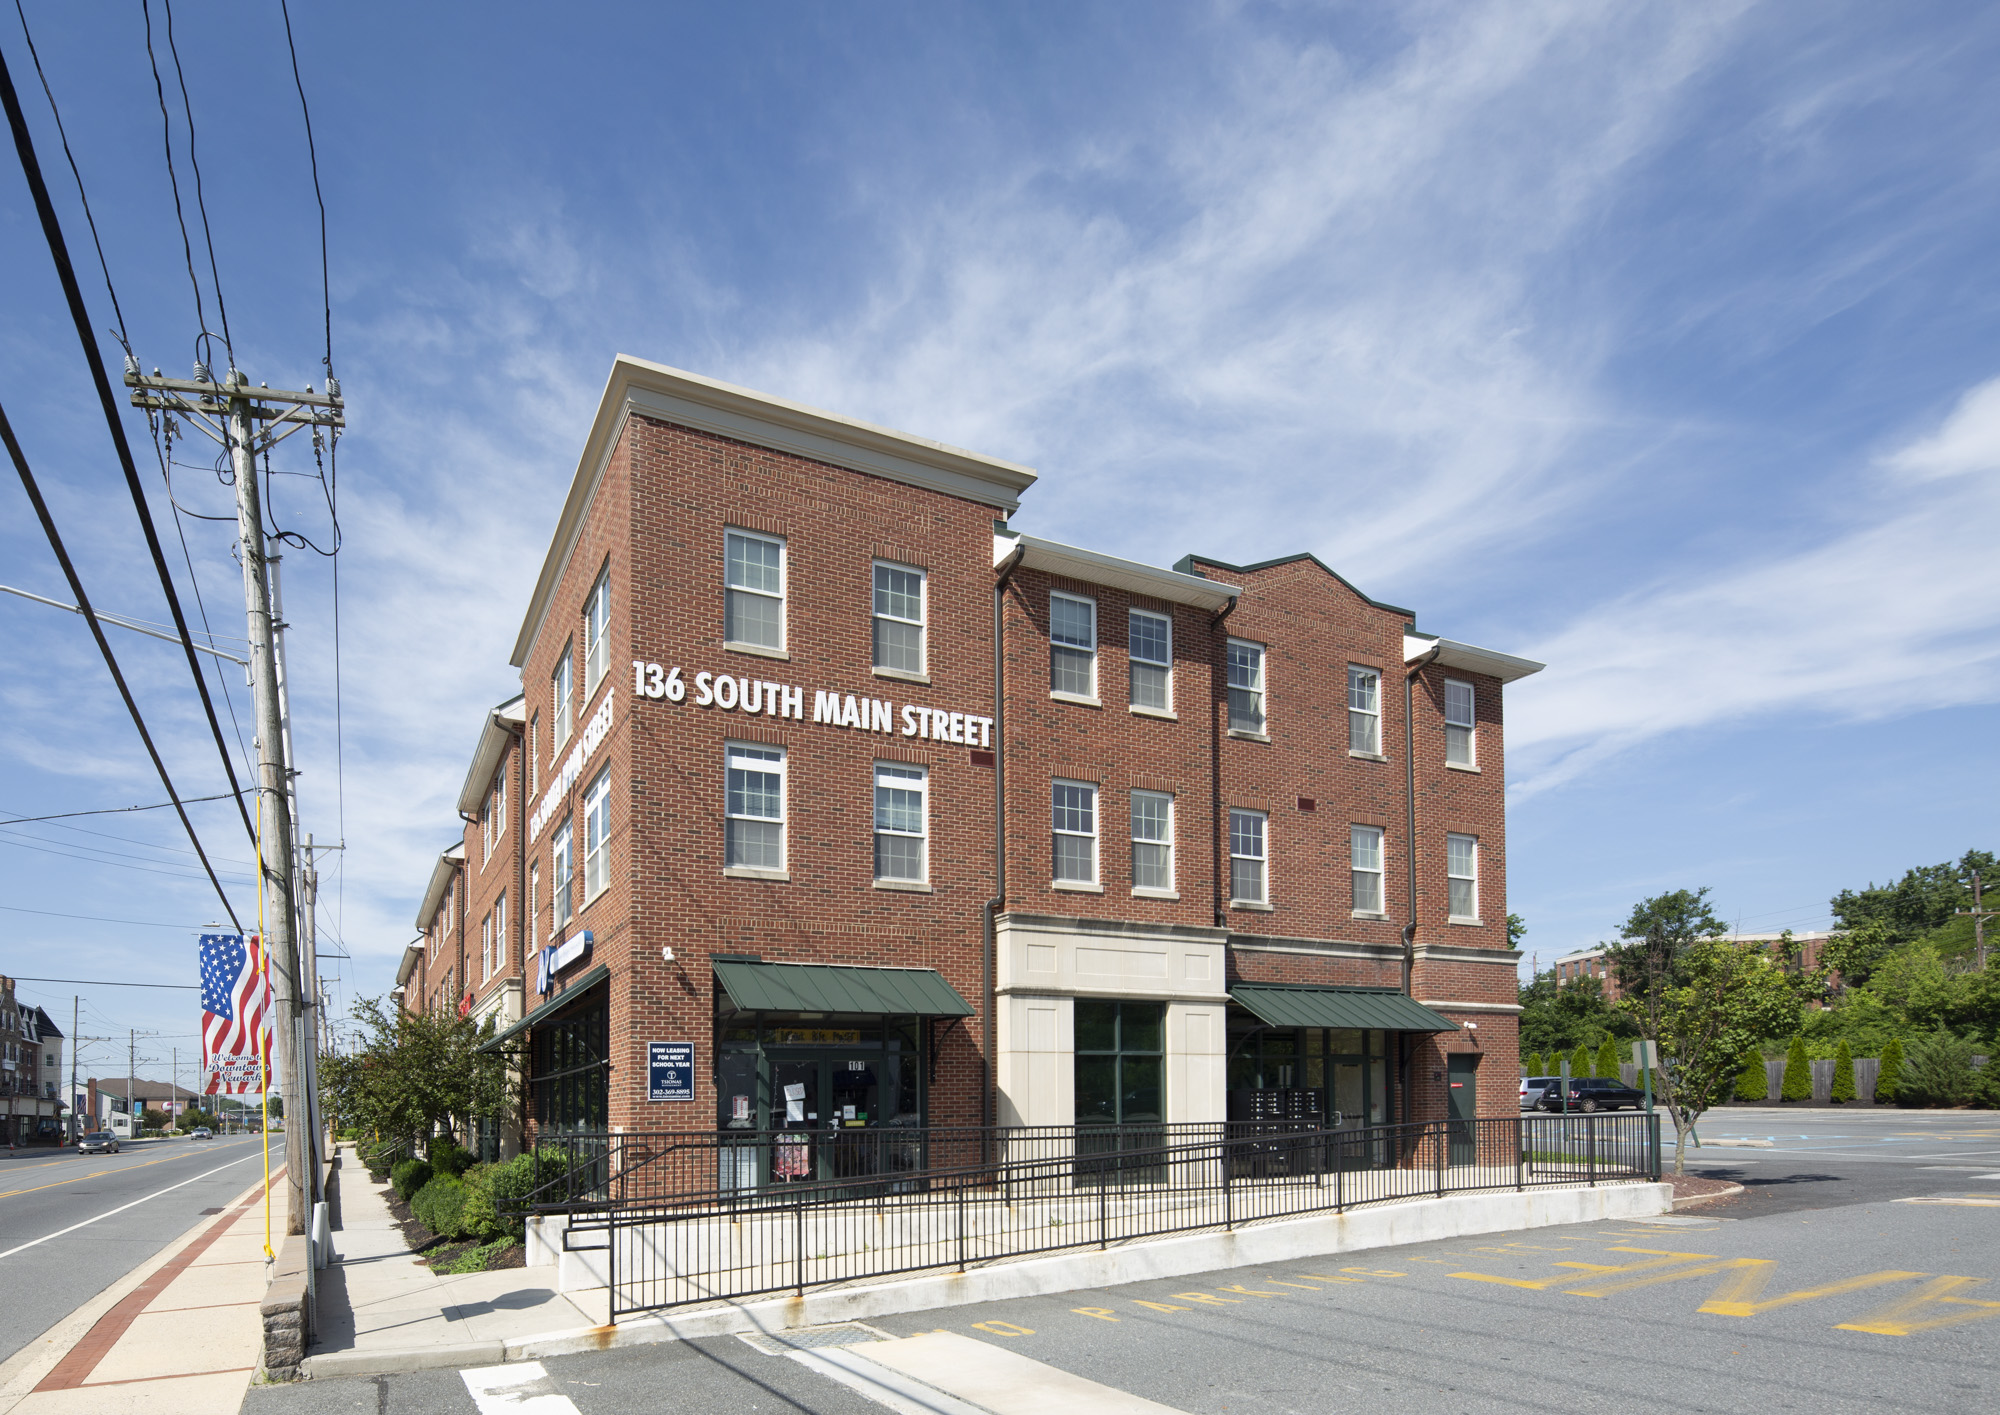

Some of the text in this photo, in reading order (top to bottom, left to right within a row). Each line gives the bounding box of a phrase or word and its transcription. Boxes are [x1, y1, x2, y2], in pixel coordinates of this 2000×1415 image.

[632, 660, 994, 749] 136 SOUTH MAIN STREET
[540, 772, 562, 830] SOUTH
[583, 686, 615, 766] STREET
[212, 1052, 255, 1062] Welcome
[217, 1073, 262, 1082] Newark
[850, 1061, 863, 1070] 101
[1069, 1266, 1409, 1323] PARKING
[1406, 1241, 1573, 1267] FIRE
